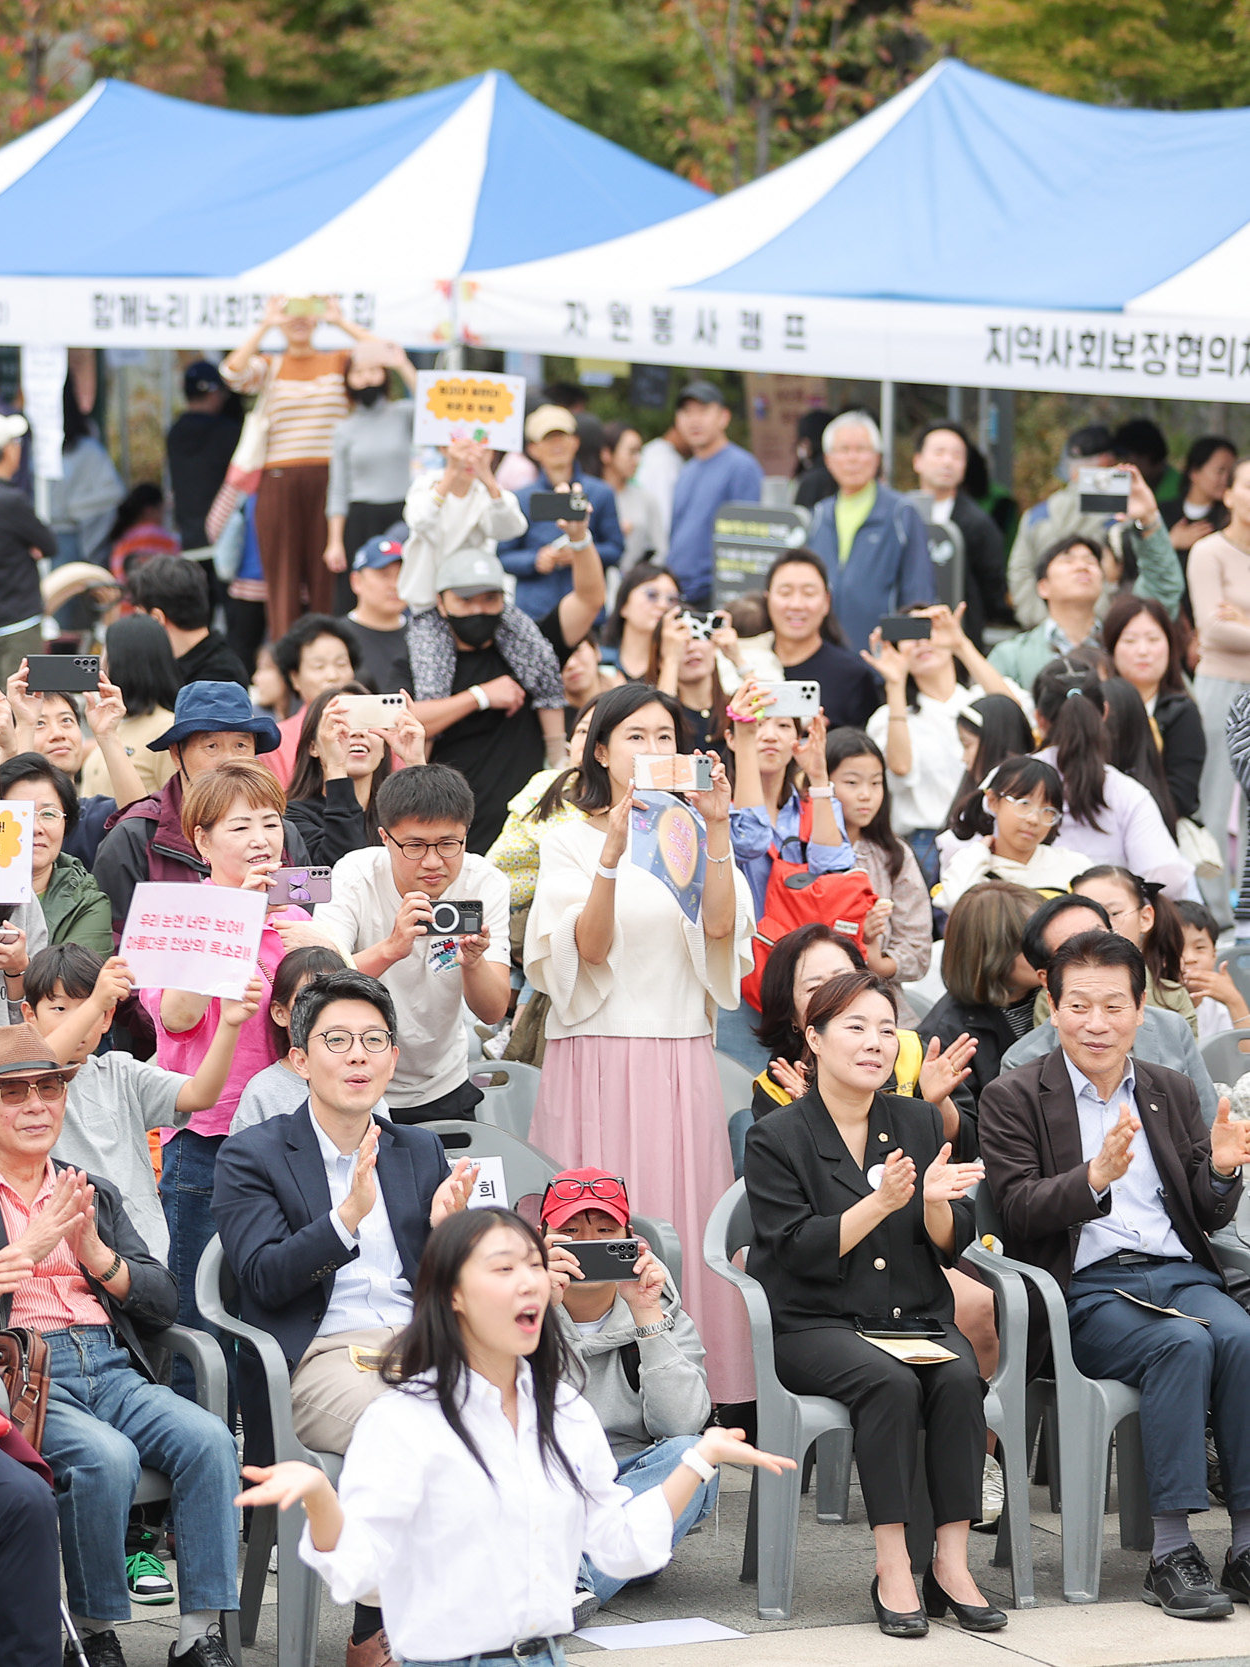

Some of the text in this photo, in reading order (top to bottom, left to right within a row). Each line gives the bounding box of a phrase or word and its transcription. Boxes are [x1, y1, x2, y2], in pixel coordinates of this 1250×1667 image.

[92, 292, 188, 331] 함께누리
[985, 324, 1250, 380] 지역사회보장협의
[139, 914, 244, 936] 우리 눈엔 너만 보여!
[126, 936, 251, 960] 아름다운 천상의 목소리!
